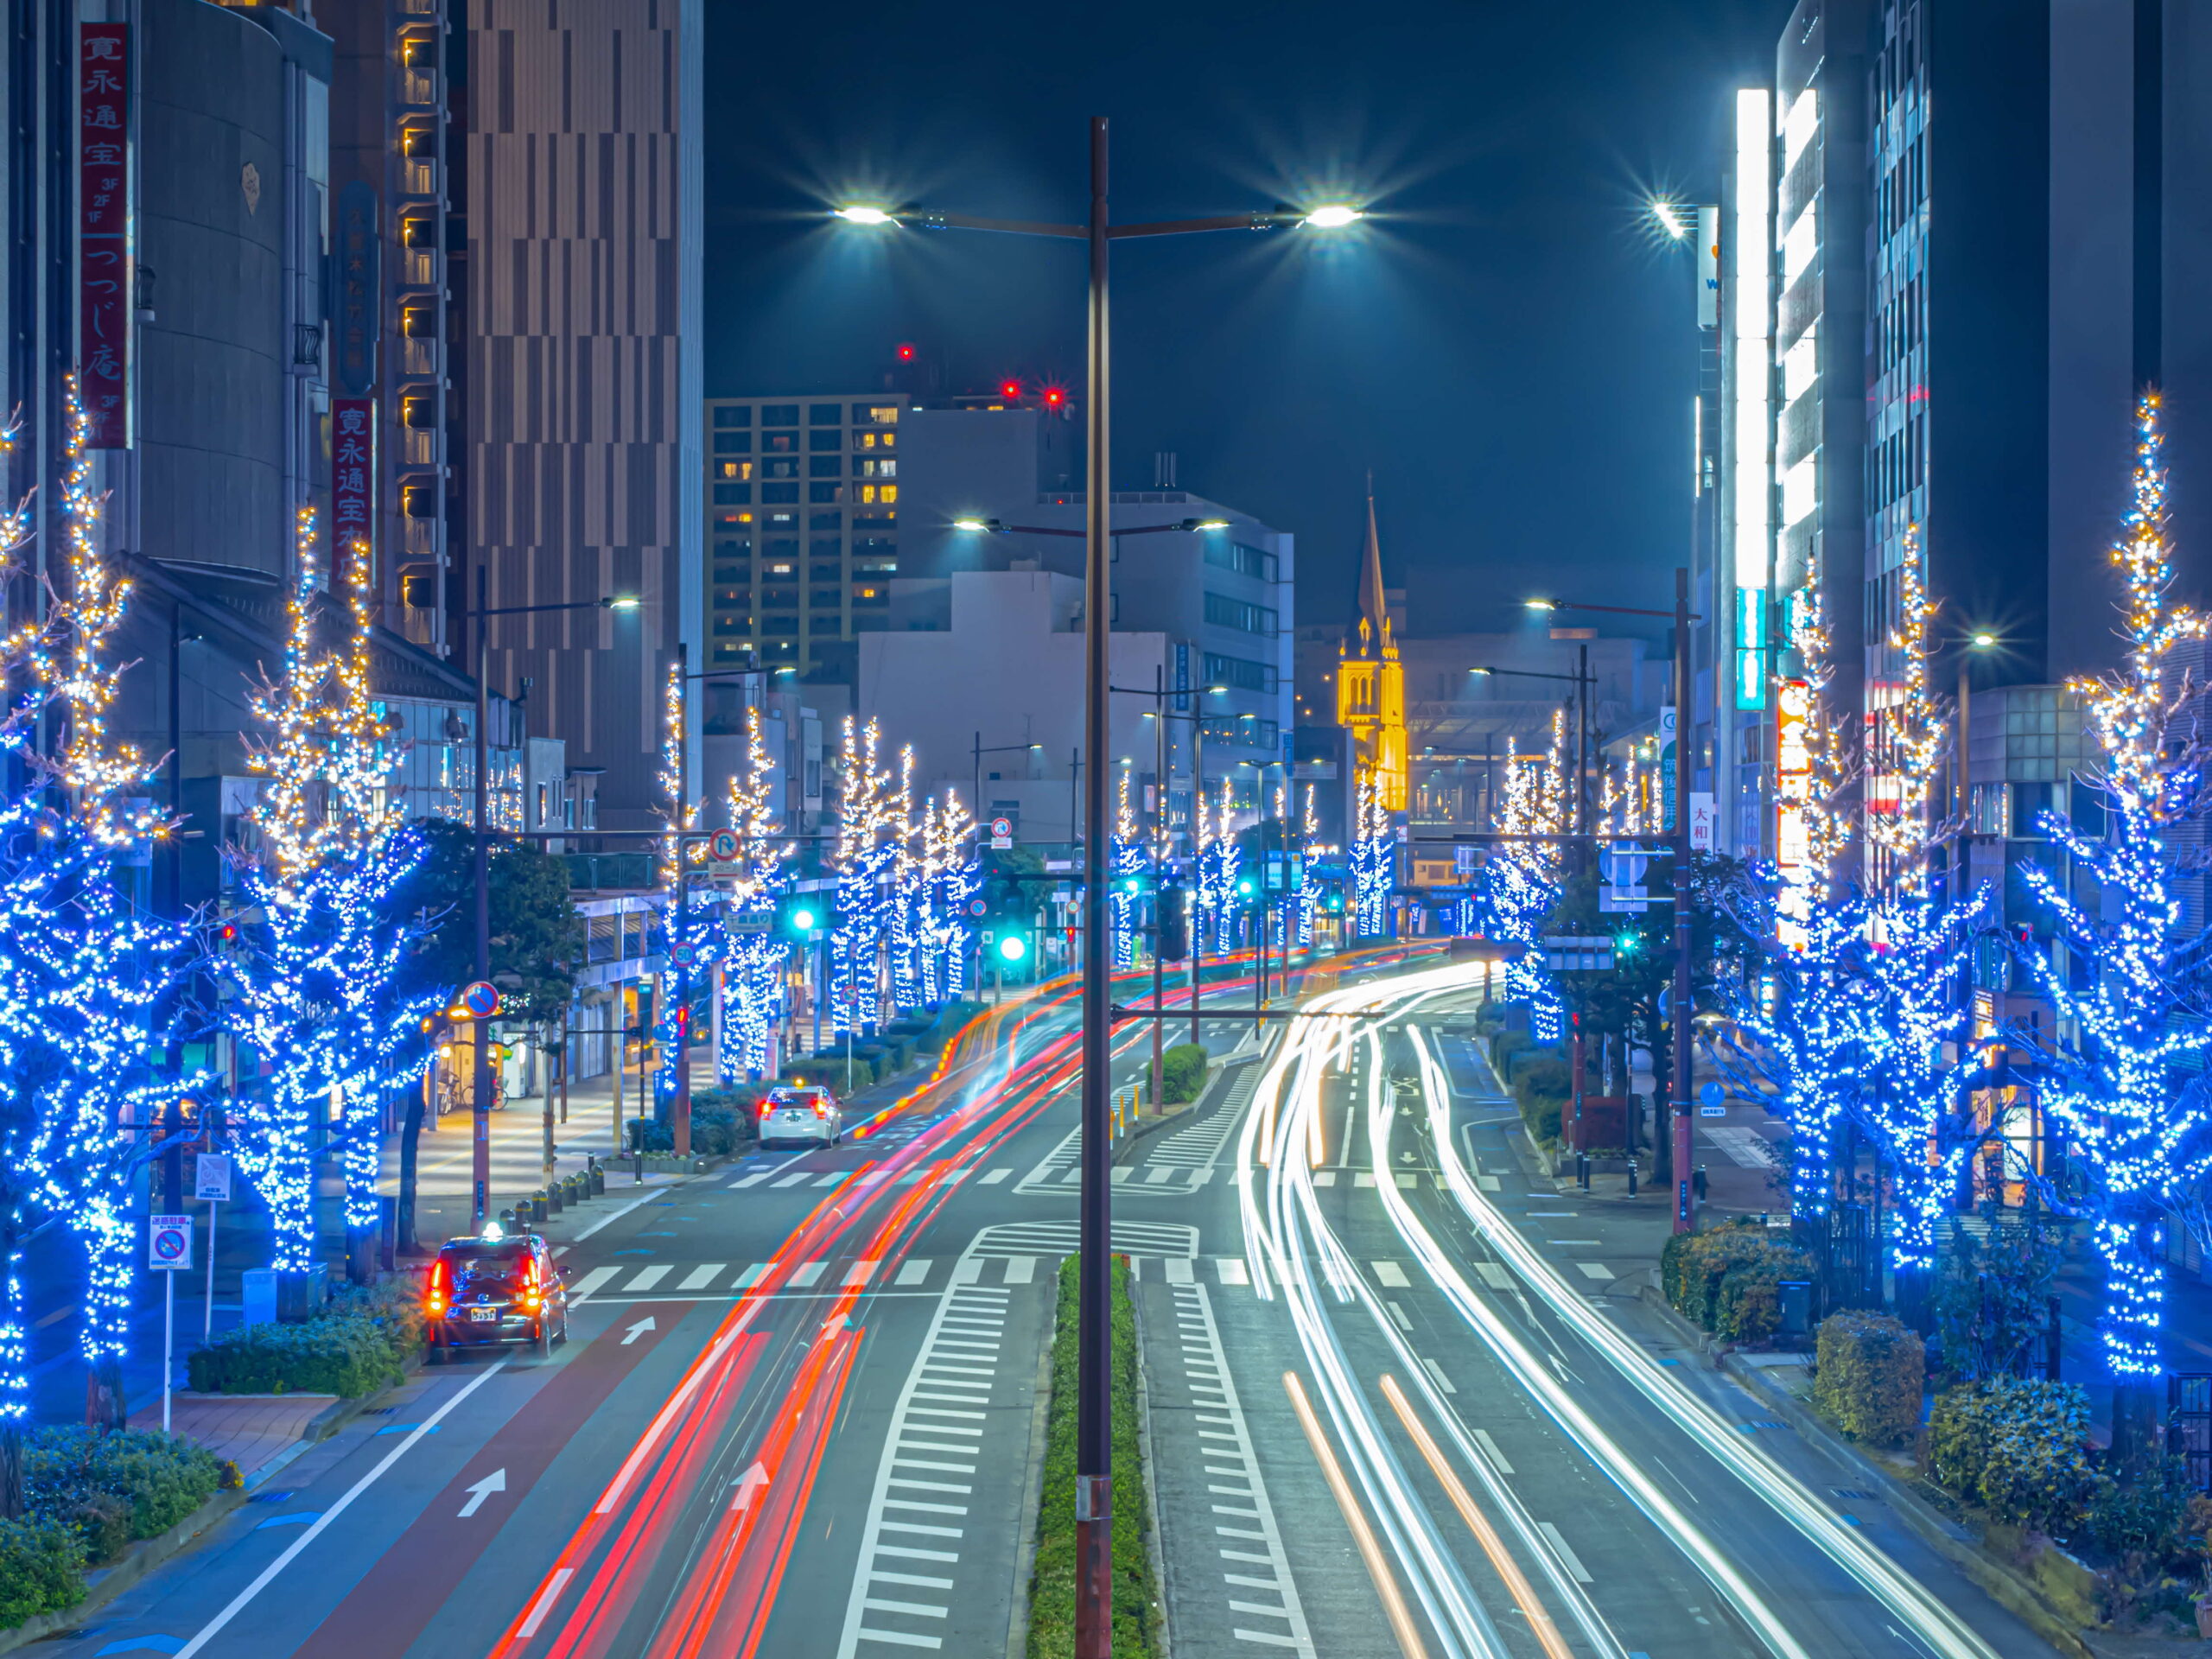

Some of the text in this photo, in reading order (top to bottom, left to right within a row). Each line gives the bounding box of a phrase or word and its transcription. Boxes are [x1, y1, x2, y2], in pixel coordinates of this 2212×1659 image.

[83, 36, 123, 166] 寛永通宝
[101, 178, 119, 191] 3F
[92, 194, 111, 207] 2F
[87, 211, 103, 224] 1F
[84, 250, 122, 381] つつじ庵
[101, 395, 120, 408] 3F
[336, 407, 367, 581] 寛永通宝
[676, 948, 690, 961] 50
